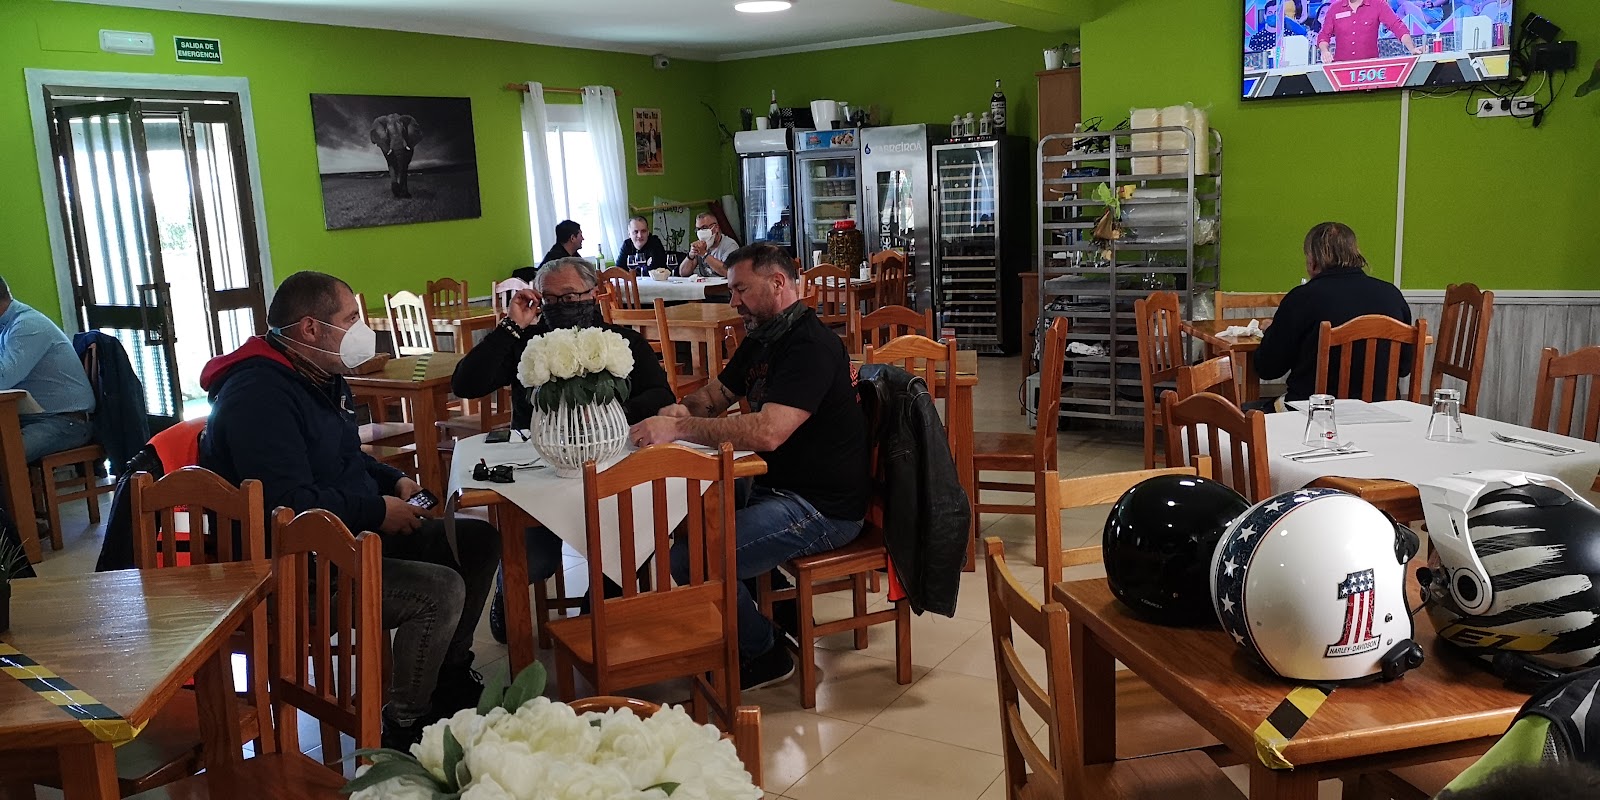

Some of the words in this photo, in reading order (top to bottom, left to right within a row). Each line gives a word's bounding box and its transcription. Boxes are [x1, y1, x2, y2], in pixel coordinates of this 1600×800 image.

[180, 41, 204, 50] SALIDA
[177, 50, 219, 58] EMERGENCIA
[1349, 68, 1387, 82] 150€
[1329, 639, 1378, 655] HARLEY-DAVIDSON
